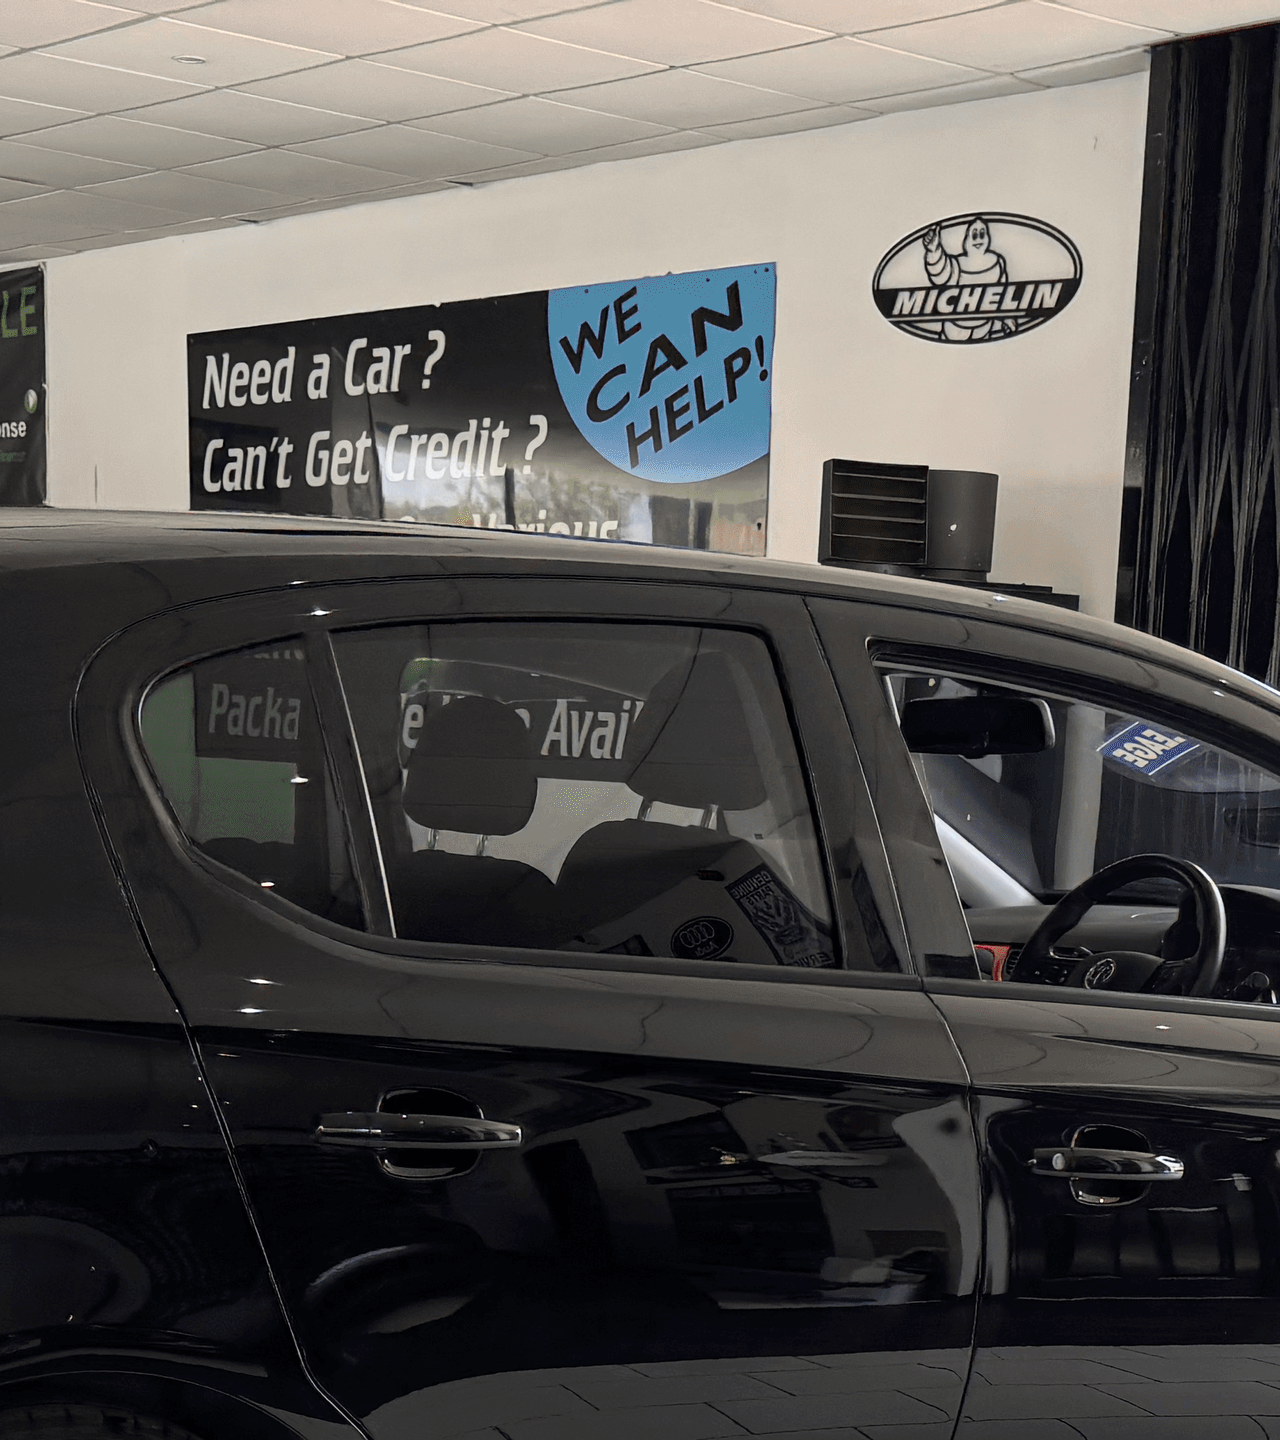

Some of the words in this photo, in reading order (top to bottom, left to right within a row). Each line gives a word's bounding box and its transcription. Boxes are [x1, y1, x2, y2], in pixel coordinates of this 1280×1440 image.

[559, 286, 642, 375] WE
[892, 282, 1063, 315] MICHELIN
[202, 346, 296, 409] Need
[307, 353, 330, 400] a
[344, 337, 412, 397] Car
[421, 329, 446, 390] ?
[586, 280, 744, 423] CAN
[626, 334, 769, 470] HELP!
[203, 436, 294, 493] Can't
[305, 430, 372, 487] Get
[384, 417, 510, 482] Credit
[522, 414, 548, 475] ?
[208, 683, 301, 740] Packa
